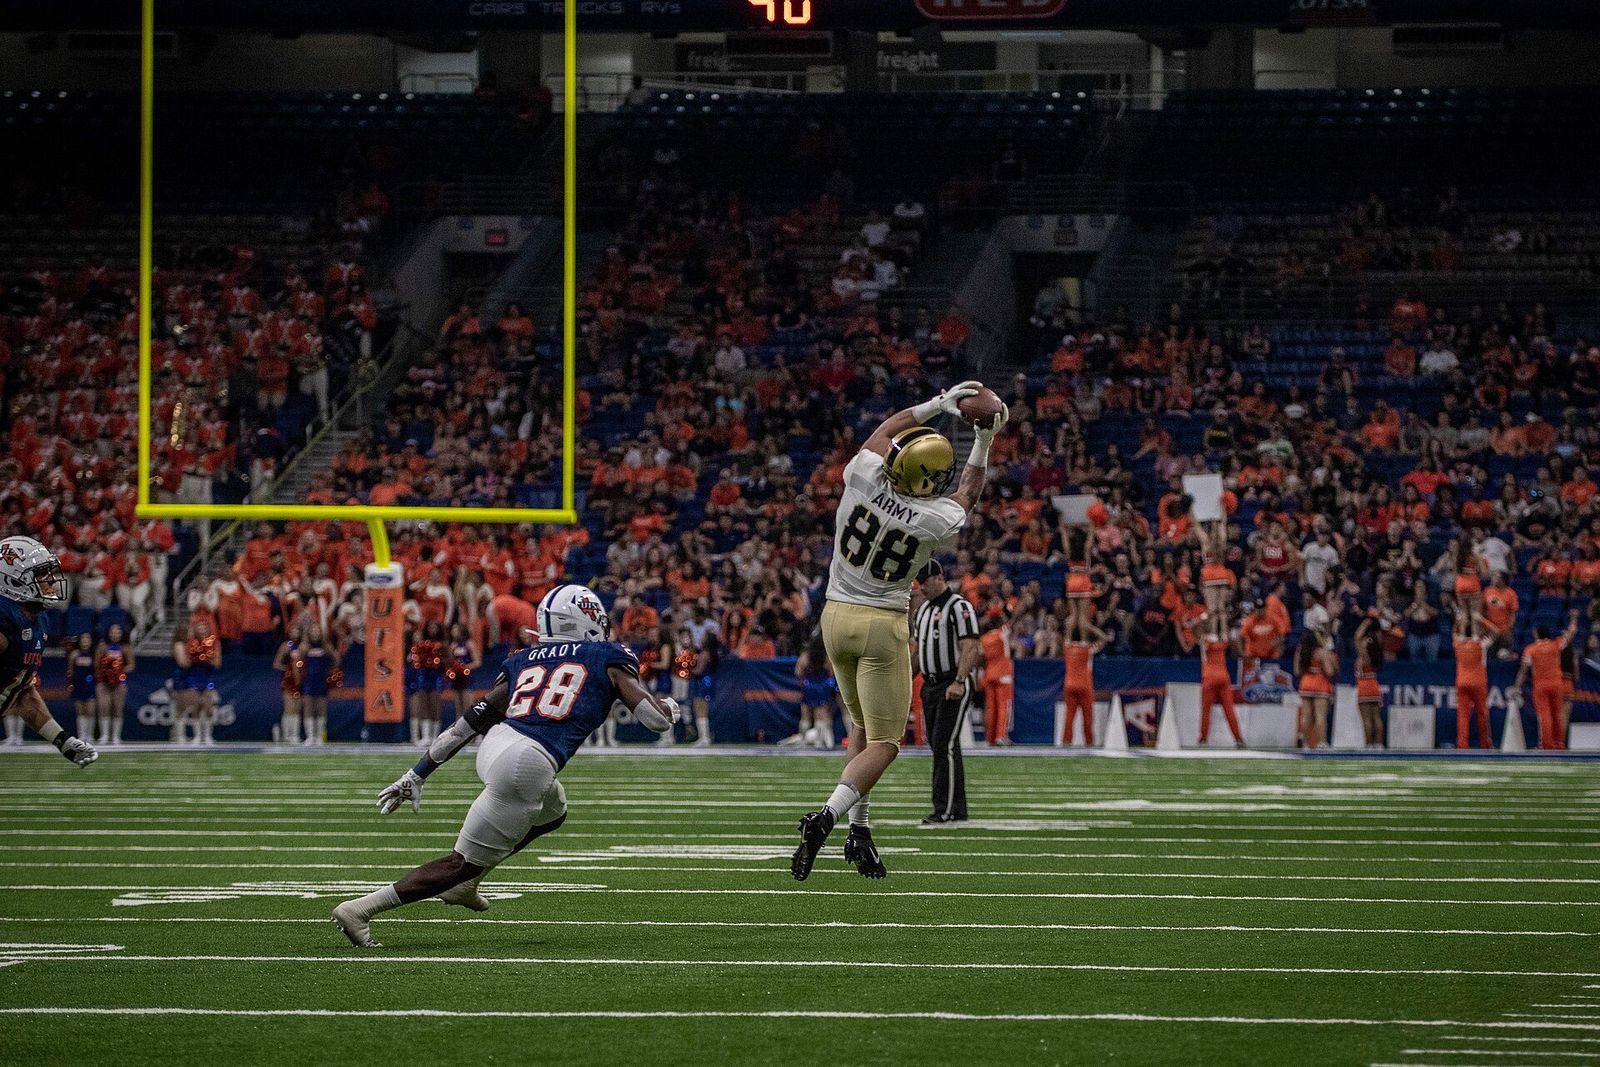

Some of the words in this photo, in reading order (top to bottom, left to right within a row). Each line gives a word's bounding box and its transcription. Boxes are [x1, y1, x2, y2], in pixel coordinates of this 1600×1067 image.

[468, 1, 527, 16] CARS
[542, 1, 623, 16] TRCKS
[876, 50, 939, 72] freight
[870, 493, 919, 524] ARMY
[839, 504, 921, 583] 88
[527, 643, 582, 661] GRADY
[505, 661, 590, 722] 28
[1393, 684, 1425, 706] IN
[1427, 685, 1525, 709] TEAS
